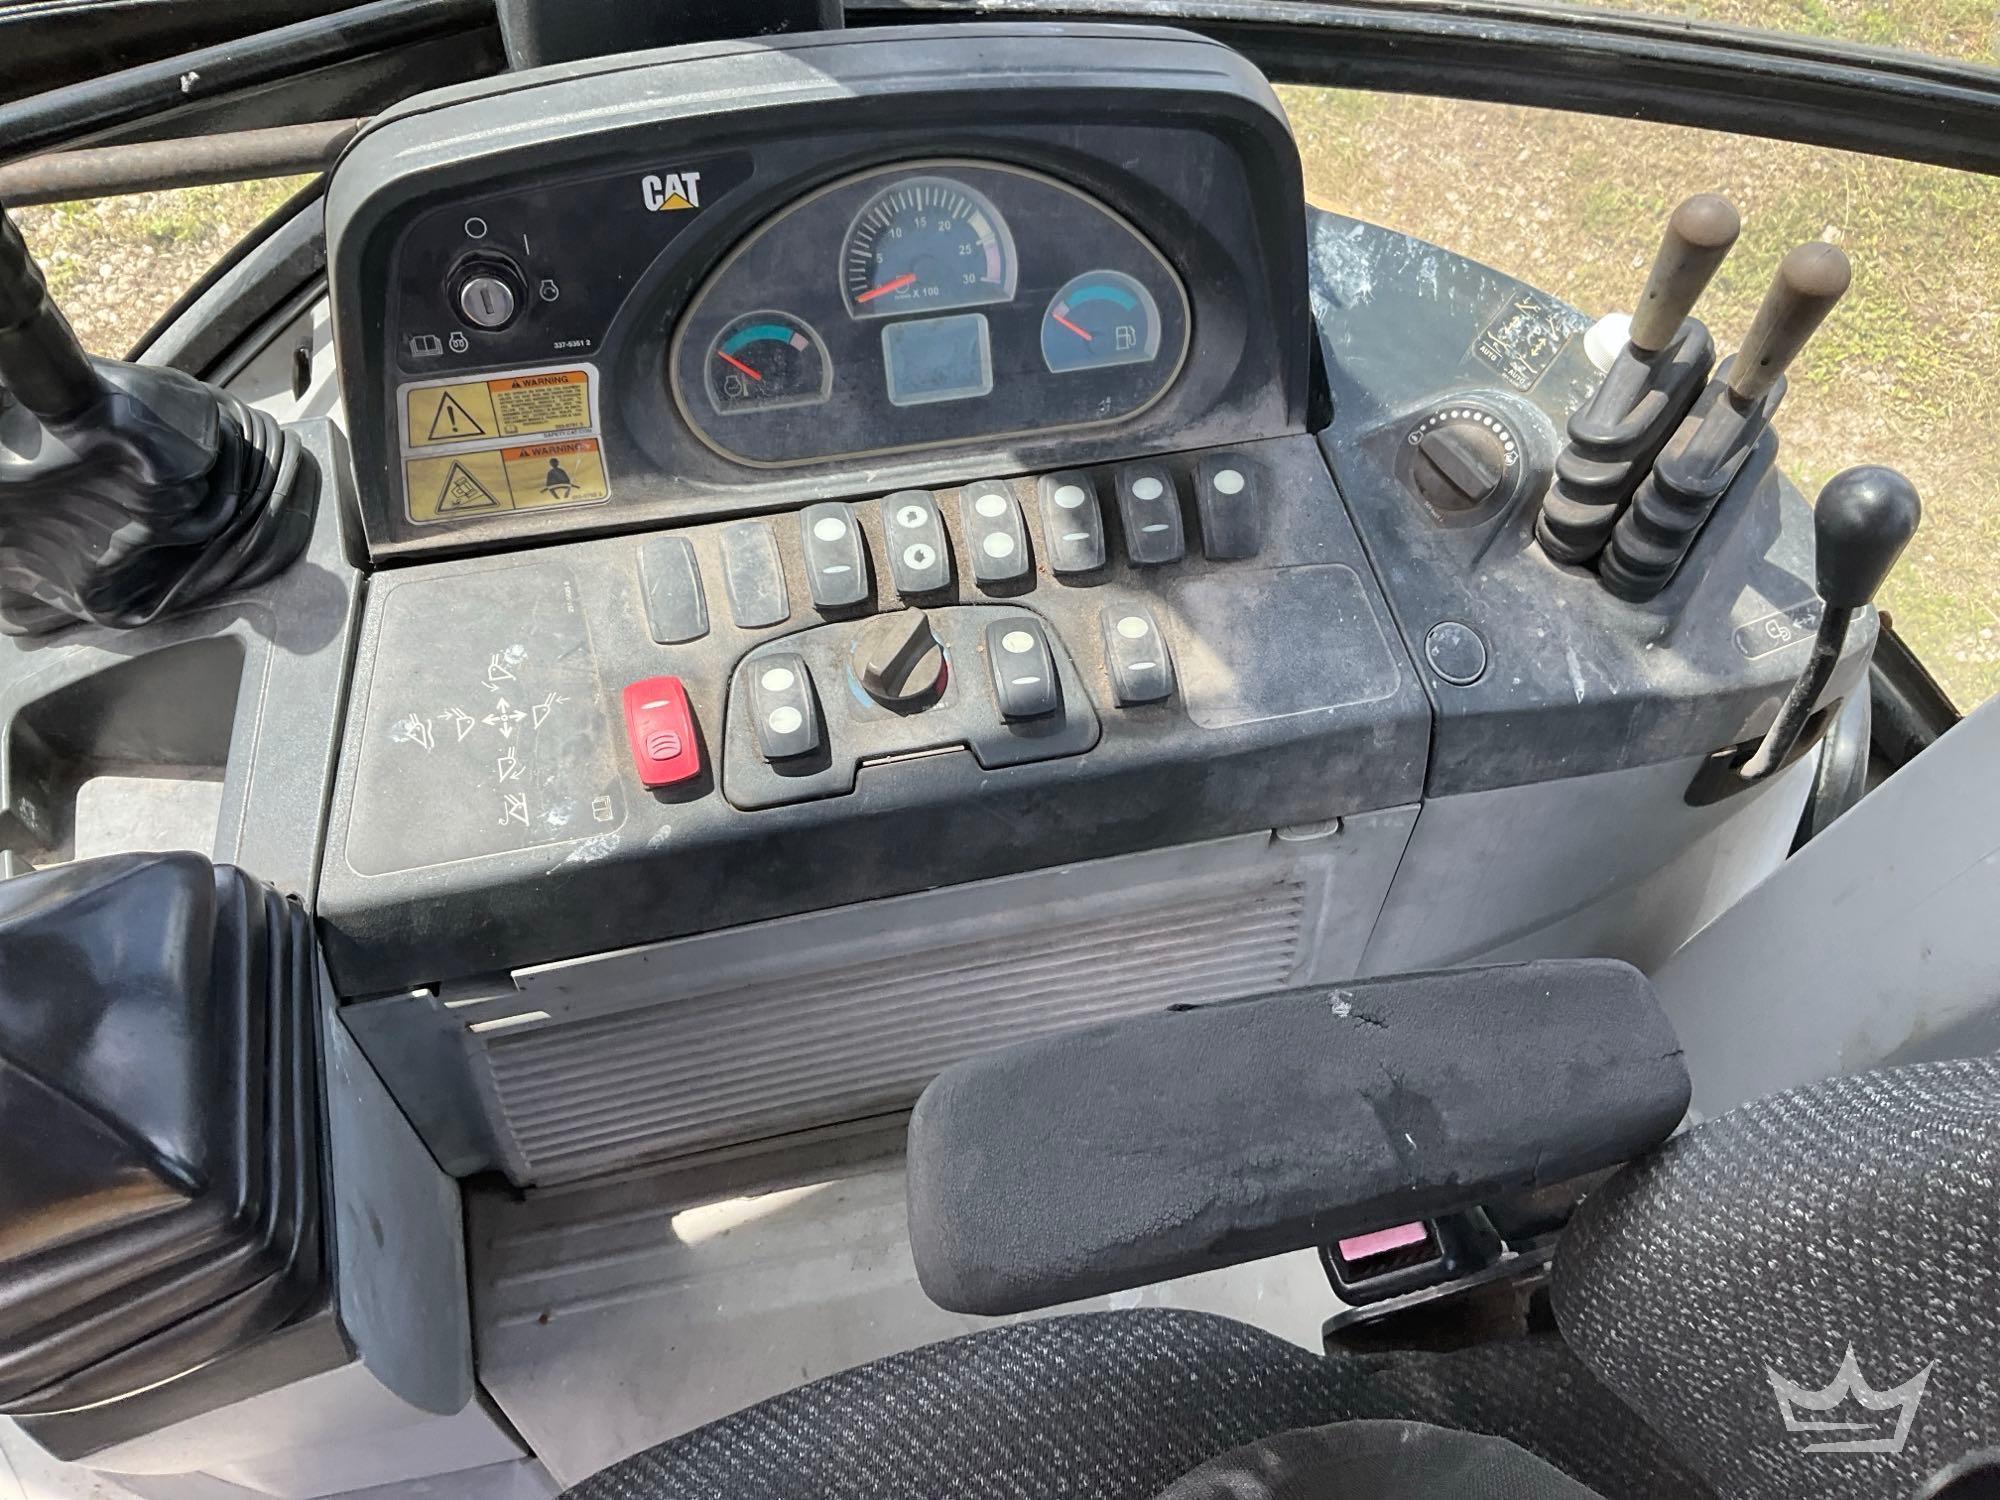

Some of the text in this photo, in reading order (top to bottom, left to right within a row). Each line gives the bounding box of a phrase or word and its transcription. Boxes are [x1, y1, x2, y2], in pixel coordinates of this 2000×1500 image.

[642, 172, 700, 211] CAT
[914, 216, 927, 228] 15
[938, 220, 951, 231] 20
[889, 228, 902, 239] 10
[959, 245, 972, 256] 25
[876, 253, 884, 264] 5
[962, 274, 976, 284] 30
[922, 287, 939, 297] 100
[1480, 345, 1497, 361] AUTO
[522, 375, 569, 388] WARNING
[1507, 369, 1525, 384] AUTO
[531, 443, 586, 457] WARNING
